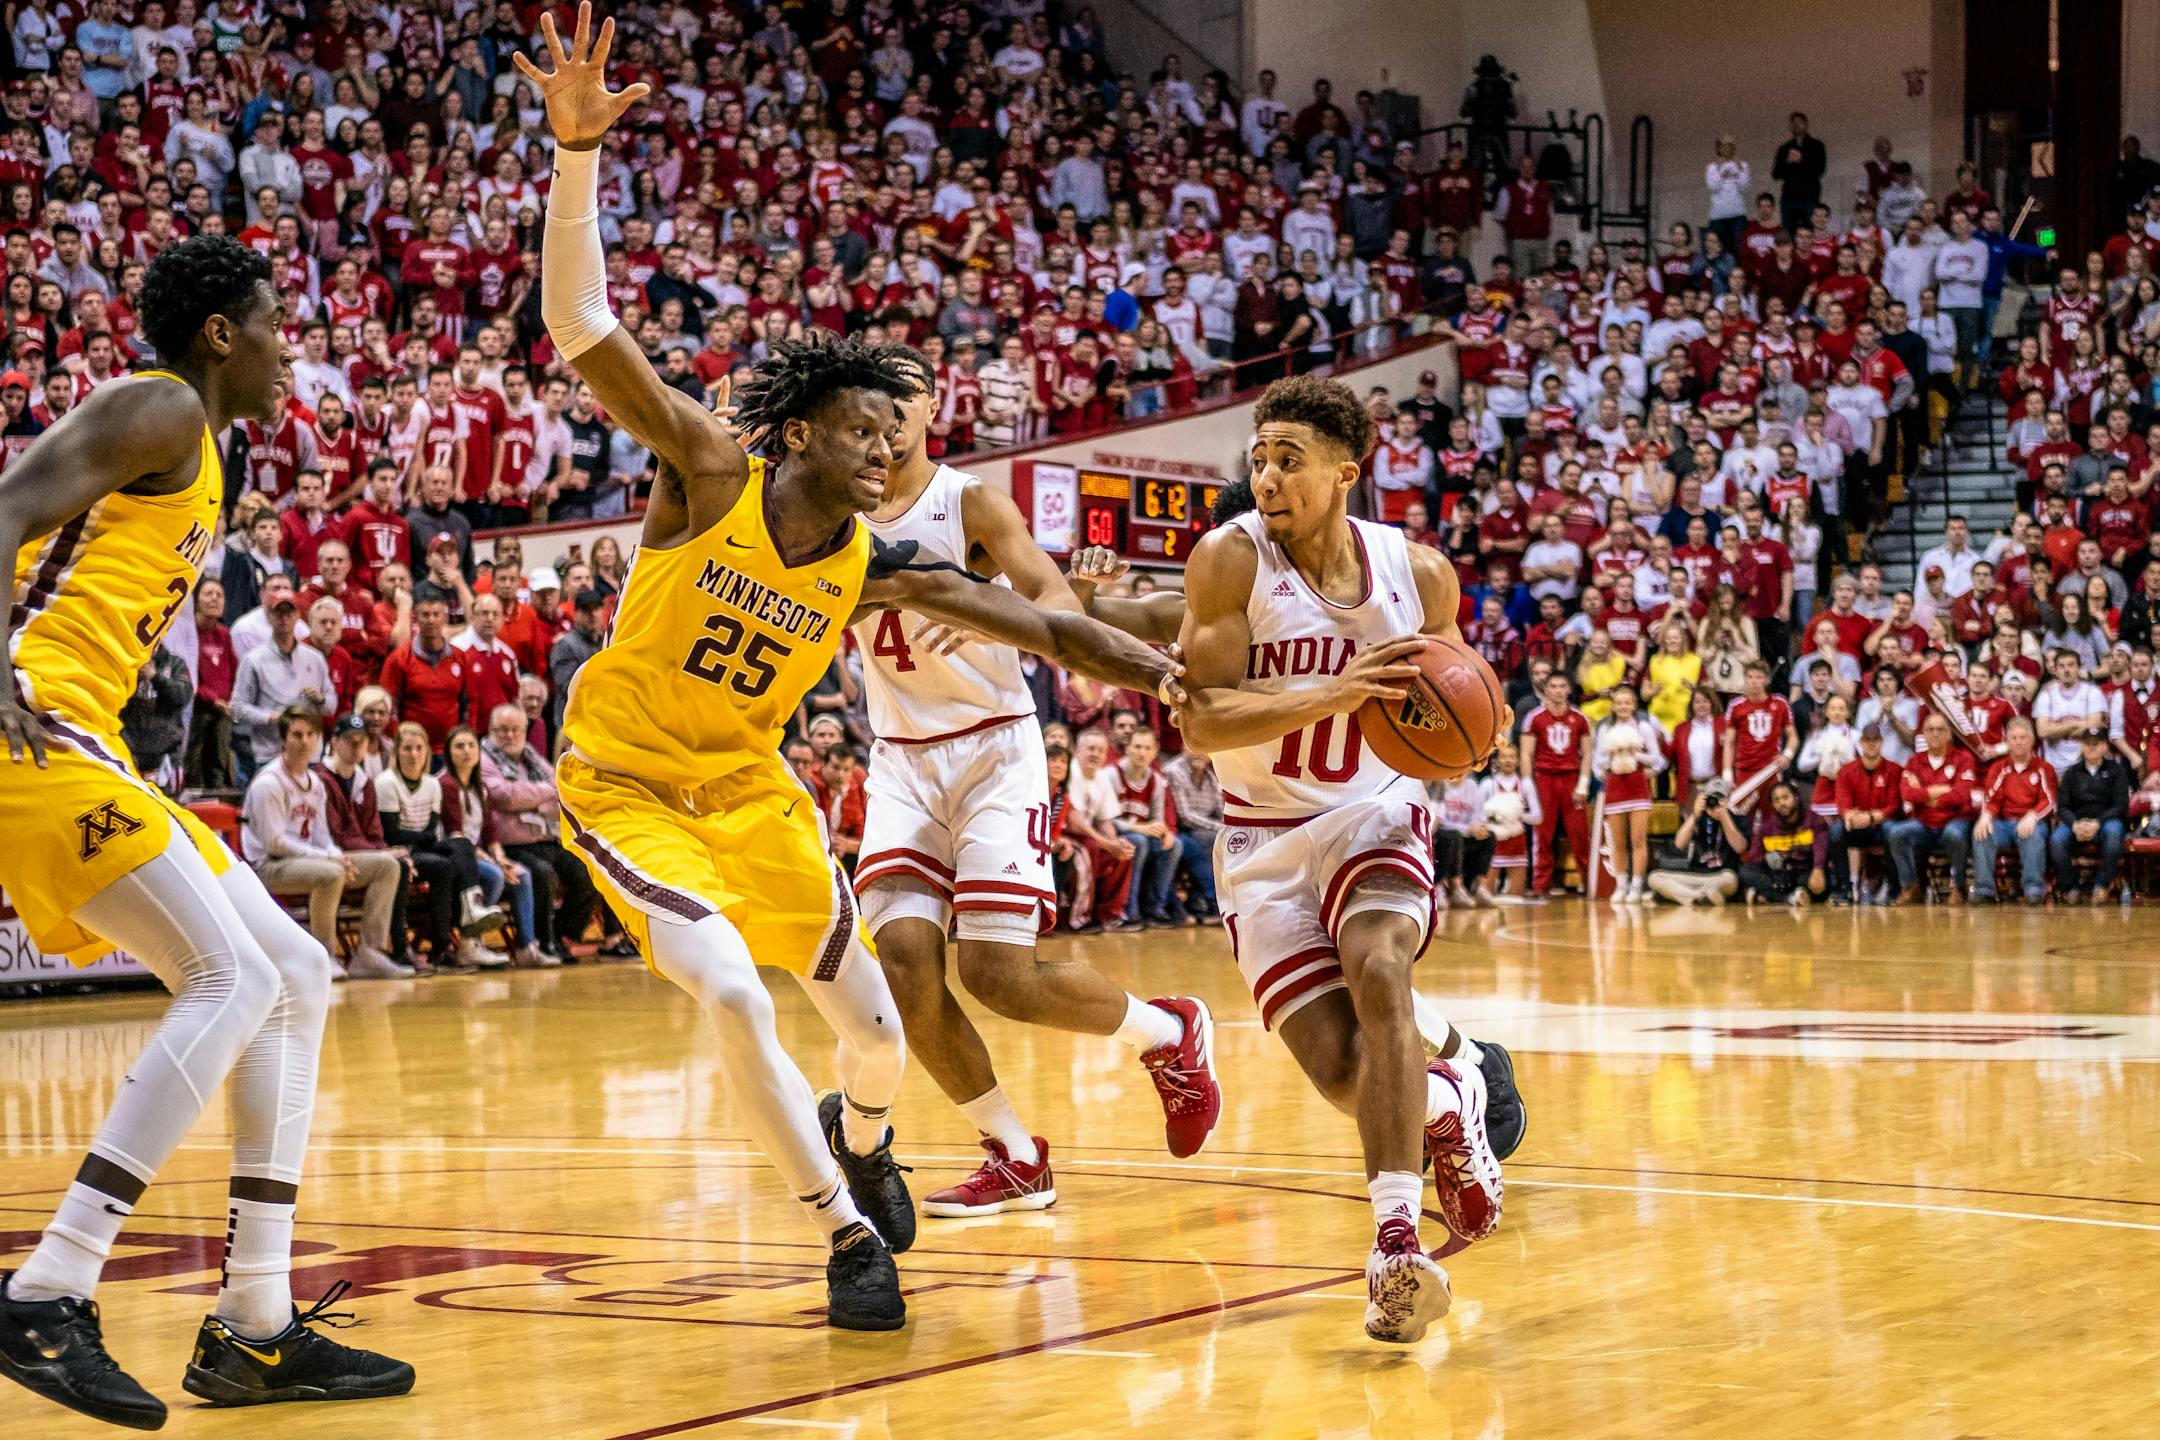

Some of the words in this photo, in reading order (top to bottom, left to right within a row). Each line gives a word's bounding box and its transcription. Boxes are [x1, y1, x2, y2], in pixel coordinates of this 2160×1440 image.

[1043, 493, 1065, 514] GO
[136, 576, 189, 647] 3
[694, 557, 833, 646] MINNESOTA
[1271, 589, 1296, 598] adidas
[681, 613, 793, 699] 25
[873, 607, 917, 673] 4
[1246, 636, 1372, 681] INDIA
[1406, 682, 1448, 731] adidas
[1271, 713, 1363, 783] 10
[74, 799, 146, 863] M
